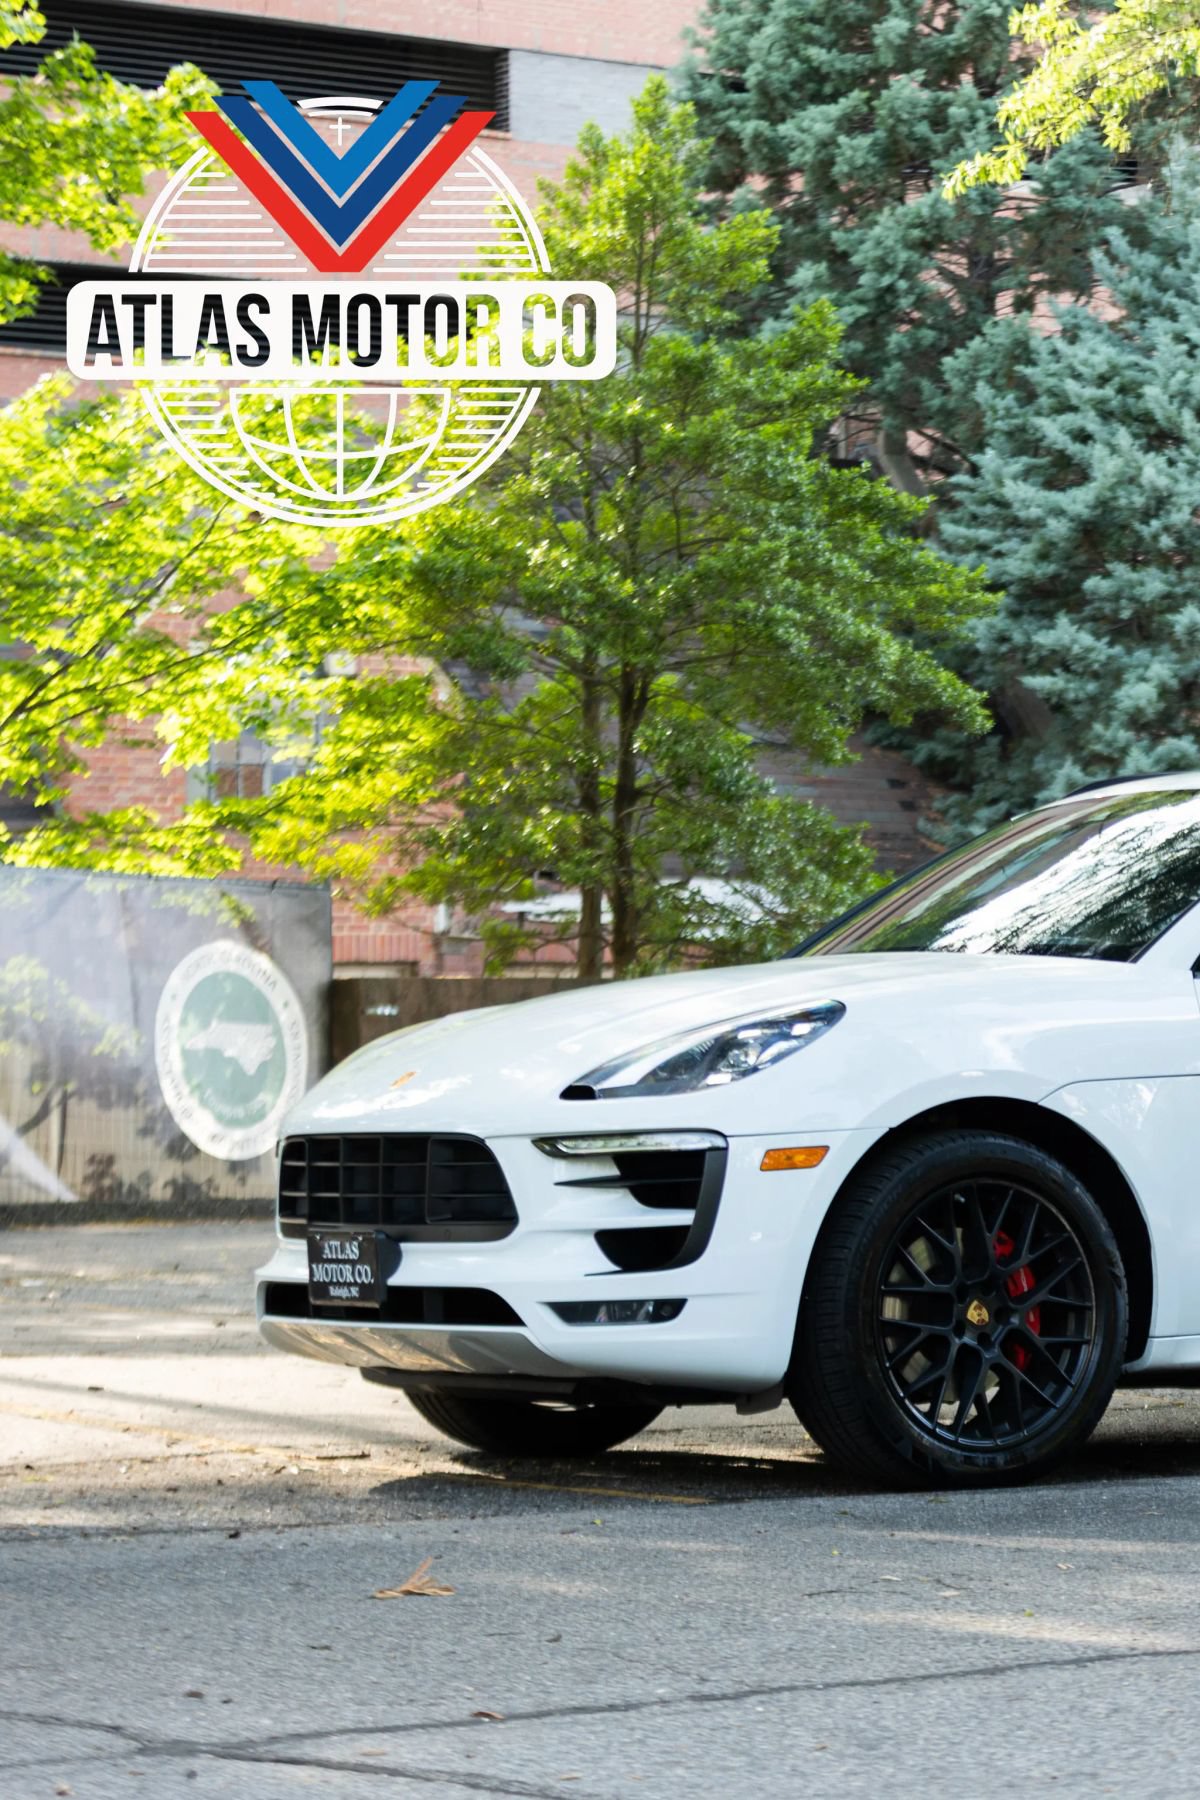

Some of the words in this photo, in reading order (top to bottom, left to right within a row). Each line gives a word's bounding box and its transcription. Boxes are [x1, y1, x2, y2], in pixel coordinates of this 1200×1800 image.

[322, 1240, 360, 1260] ATLAS
[311, 1263, 354, 1283] MOTOR
[355, 1264, 374, 1284] CO.
